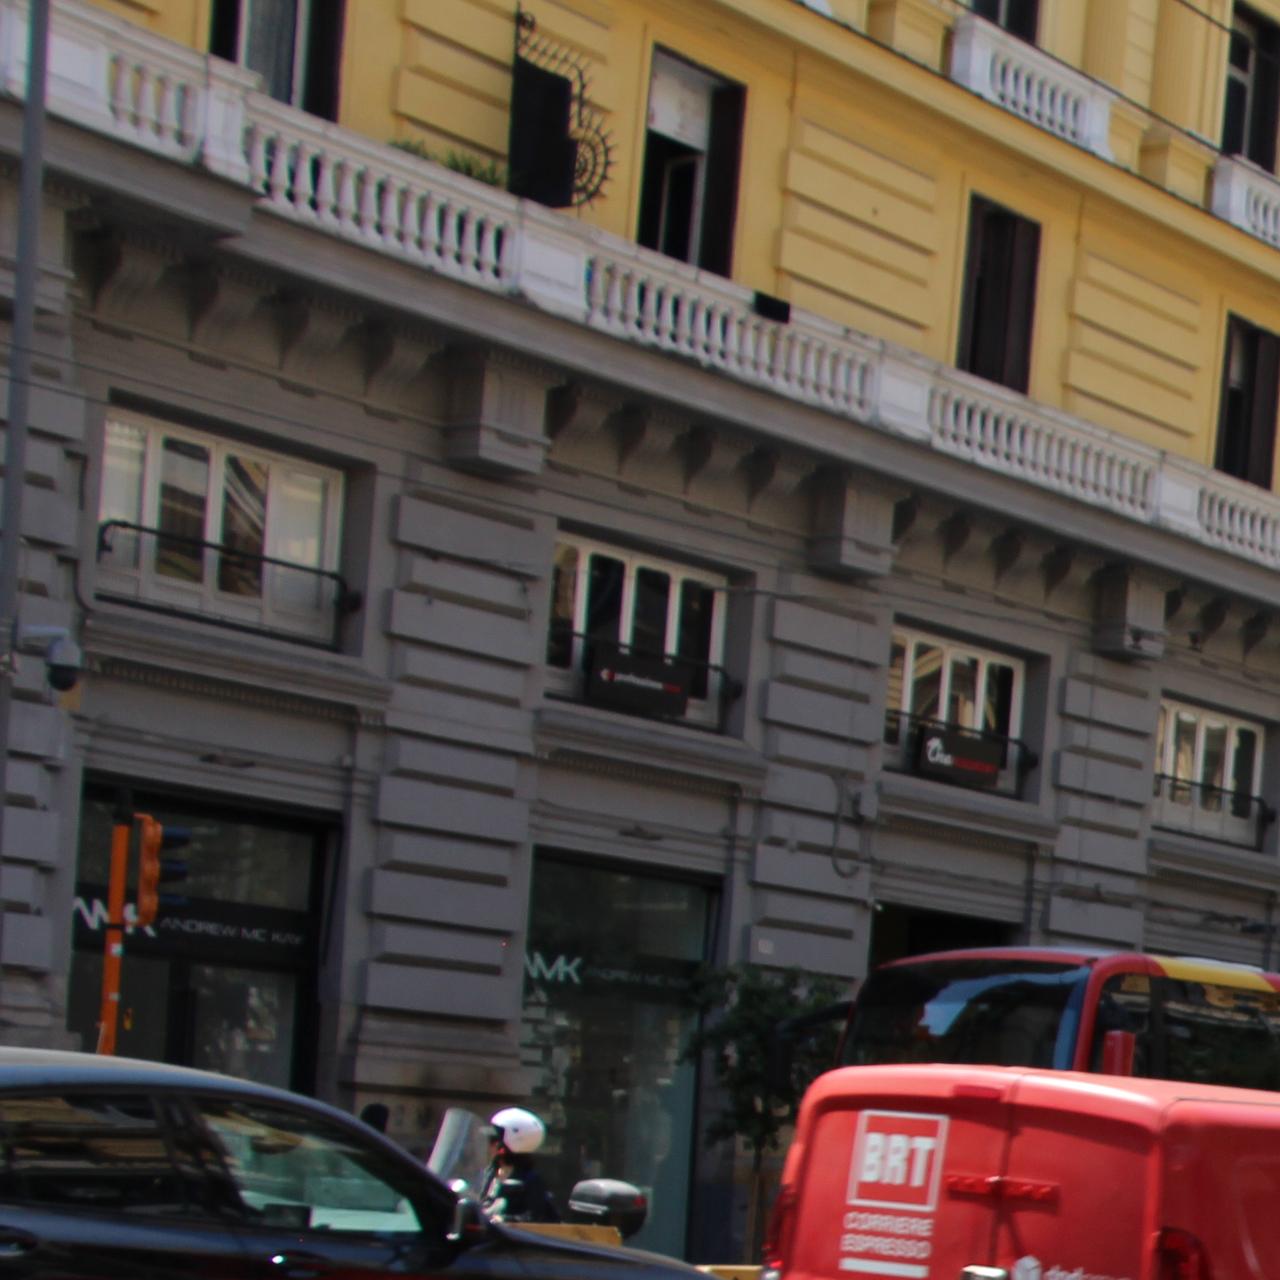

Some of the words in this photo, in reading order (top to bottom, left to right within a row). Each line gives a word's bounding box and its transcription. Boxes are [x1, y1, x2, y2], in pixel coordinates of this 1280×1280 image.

[859, 1131, 937, 1187] BRT
[843, 1211, 934, 1237] CORRIERE
[840, 1233, 933, 1260] ESPRESSO
